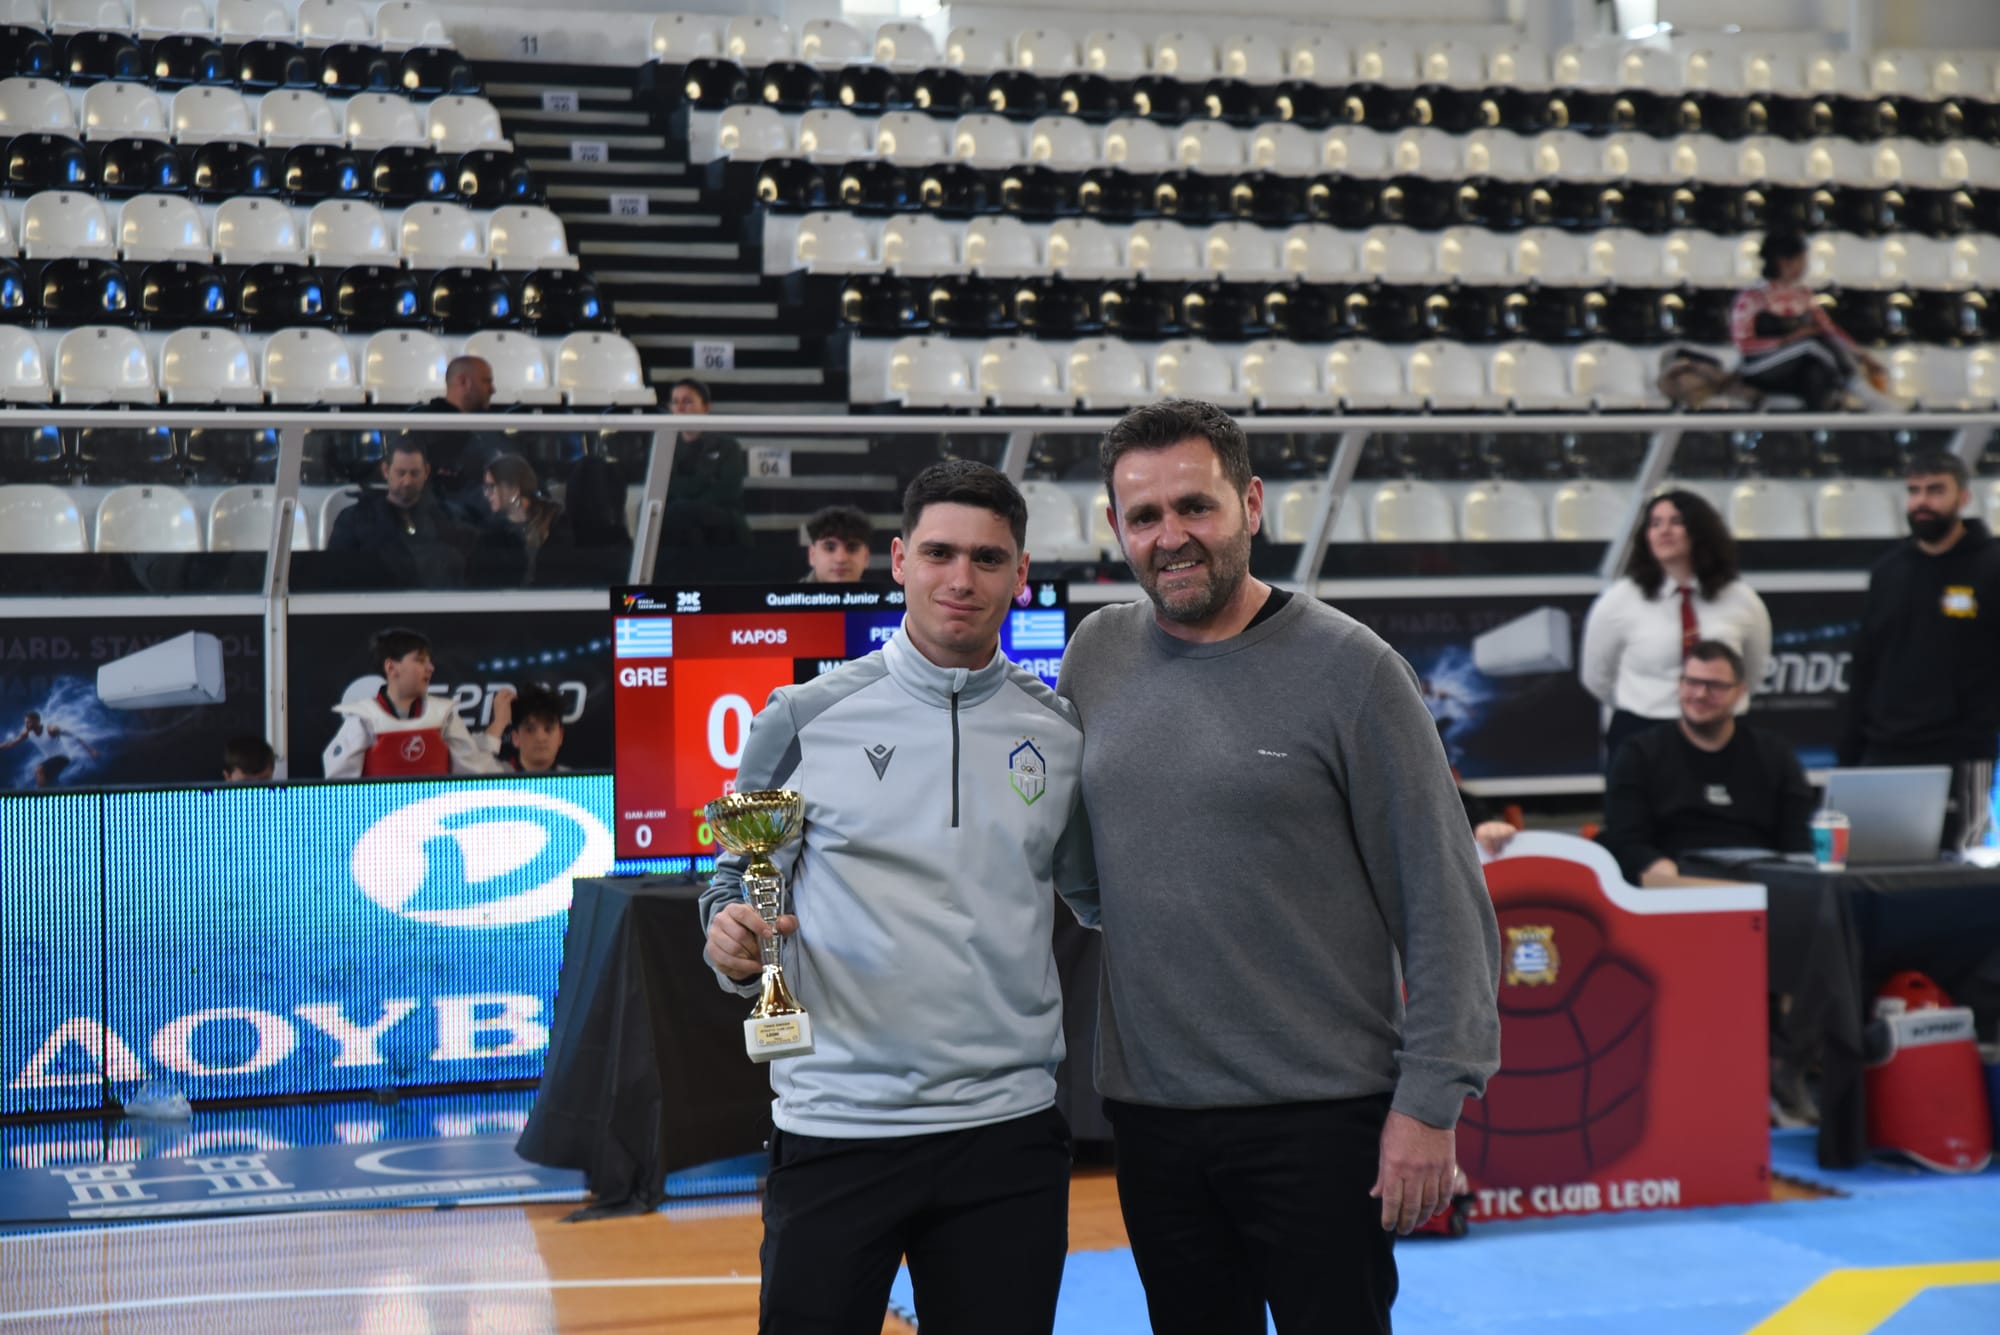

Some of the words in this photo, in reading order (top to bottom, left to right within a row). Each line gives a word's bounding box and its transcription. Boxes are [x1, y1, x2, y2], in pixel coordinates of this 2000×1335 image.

[521, 35, 538, 54] 11
[766, 592, 840, 606] Qualification
[842, 592, 880, 604] Junior
[731, 629, 788, 645] KAPOS
[619, 666, 668, 687] GRE
[707, 693, 754, 769] 0
[635, 824, 652, 848] 0
[697, 822, 714, 846] 0
[1470, 1187, 1523, 1217] TIC
[1530, 1181, 1601, 1213] CLUB
[1608, 1177, 1681, 1209] LEON
